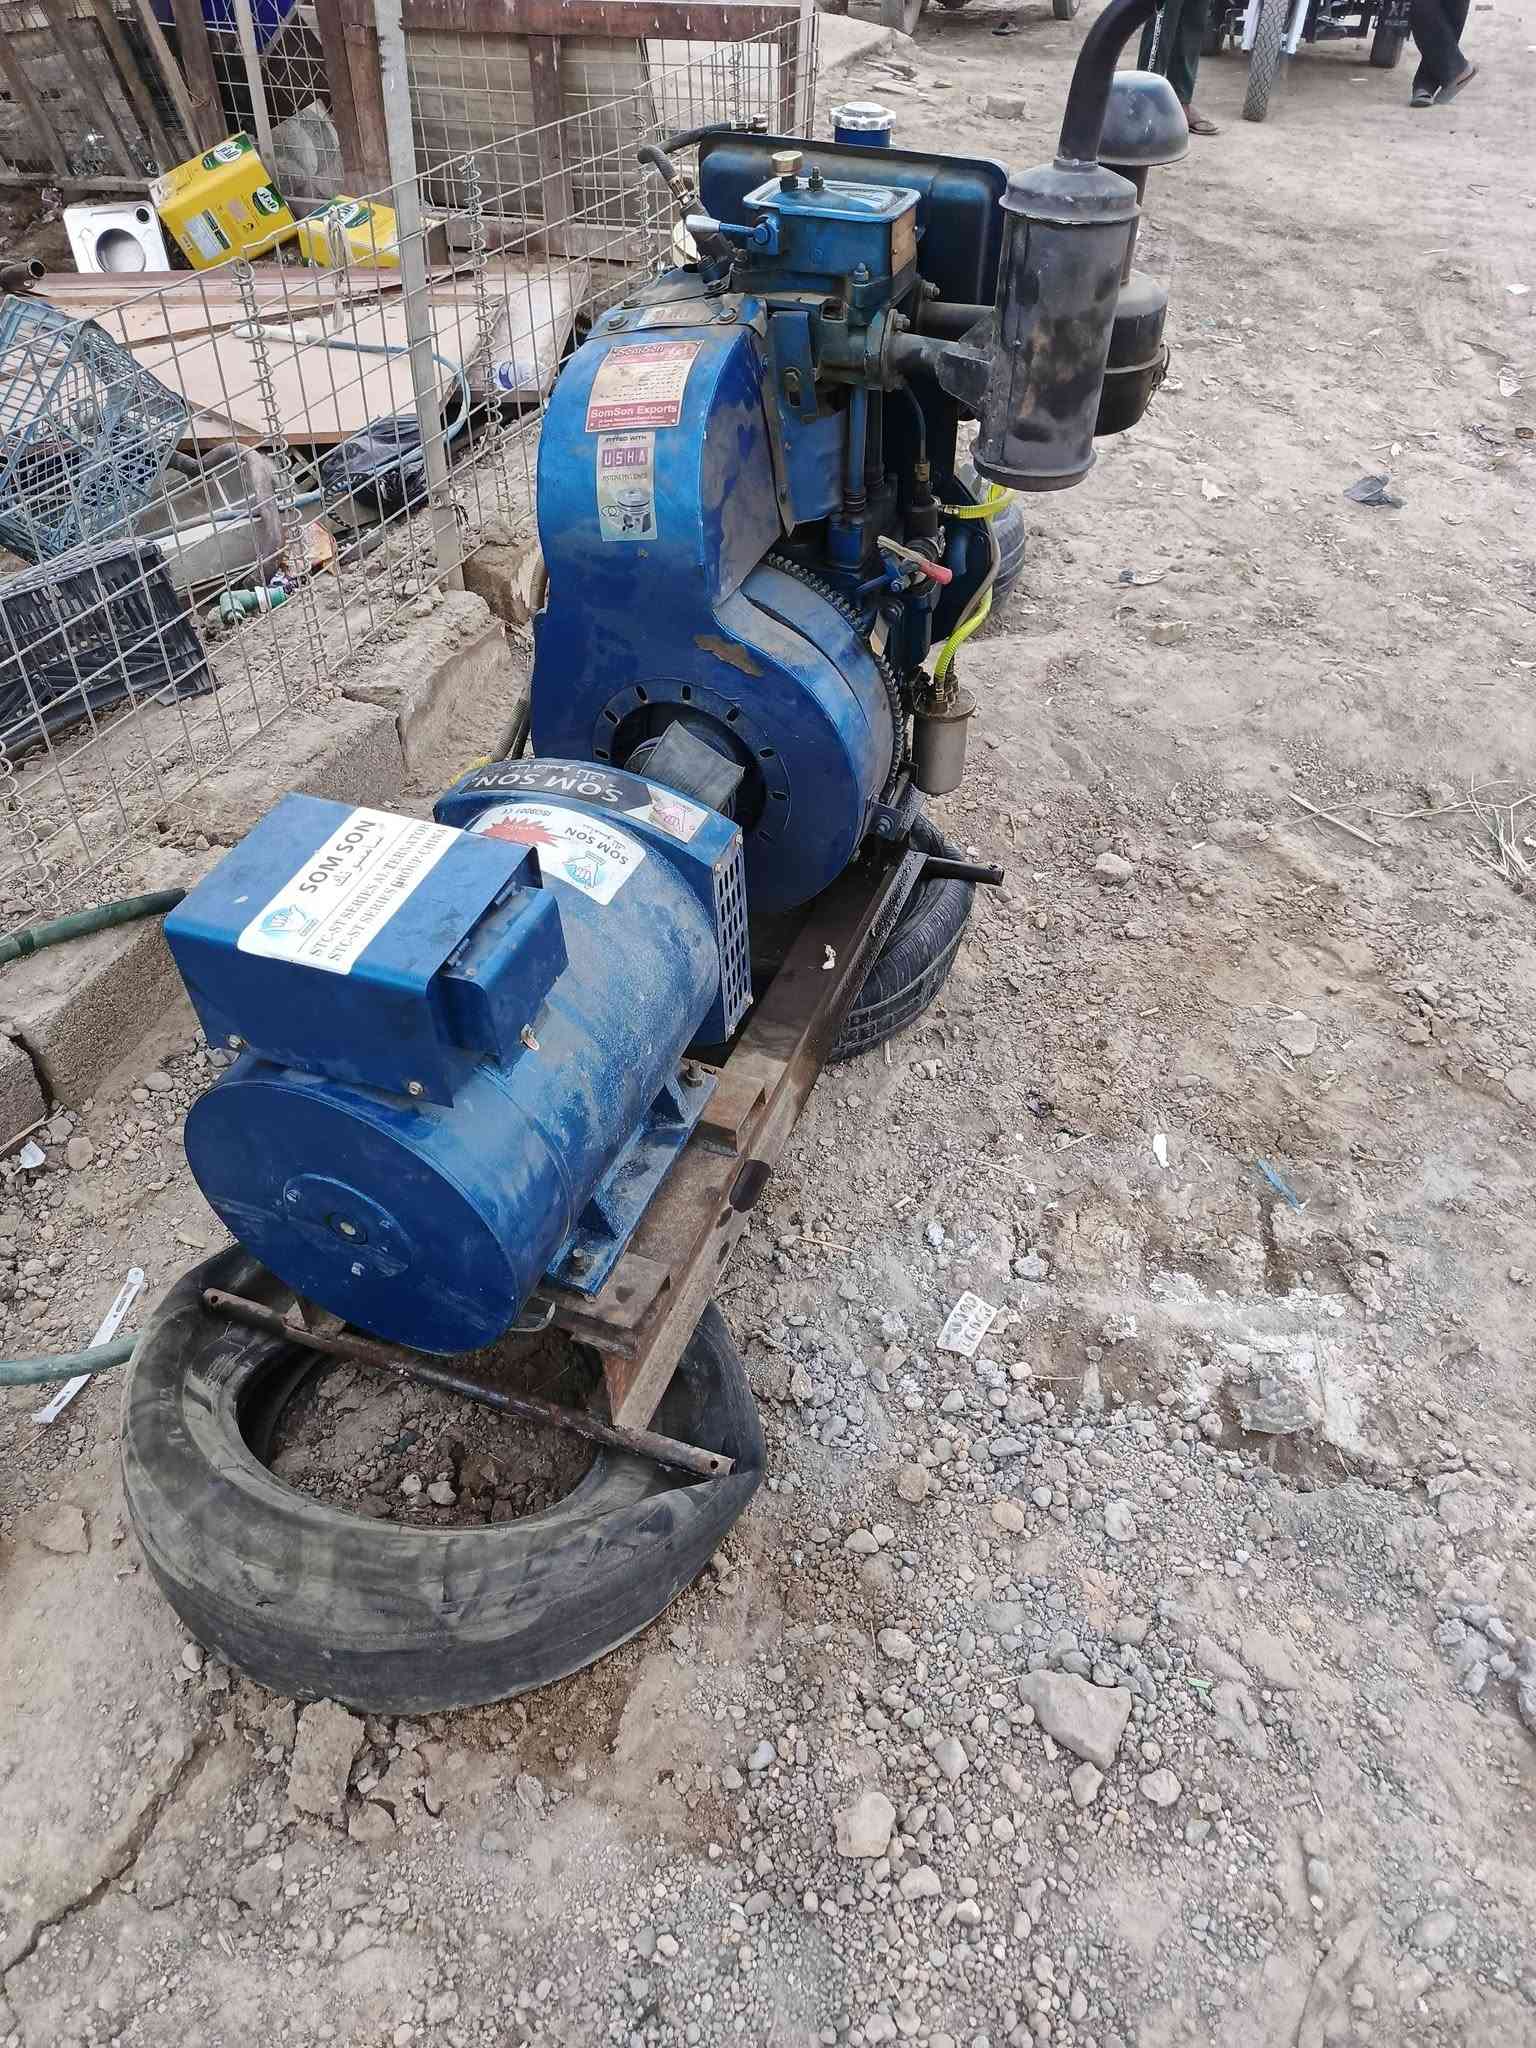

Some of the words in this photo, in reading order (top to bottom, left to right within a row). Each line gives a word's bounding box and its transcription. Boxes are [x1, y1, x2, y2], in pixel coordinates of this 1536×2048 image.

[591, 407, 634, 418] SomSon
[637, 405, 677, 416] Exports
[604, 448, 647, 466] USHA
[474, 773, 536, 788] SON
[544, 774, 623, 803] SOM
[564, 826, 594, 845] SON
[299, 855, 343, 894] SOM
[336, 820, 377, 853] SON
[597, 840, 629, 865] SOM
[342, 884, 378, 919] SERIES
[359, 888, 397, 925] SERIES
